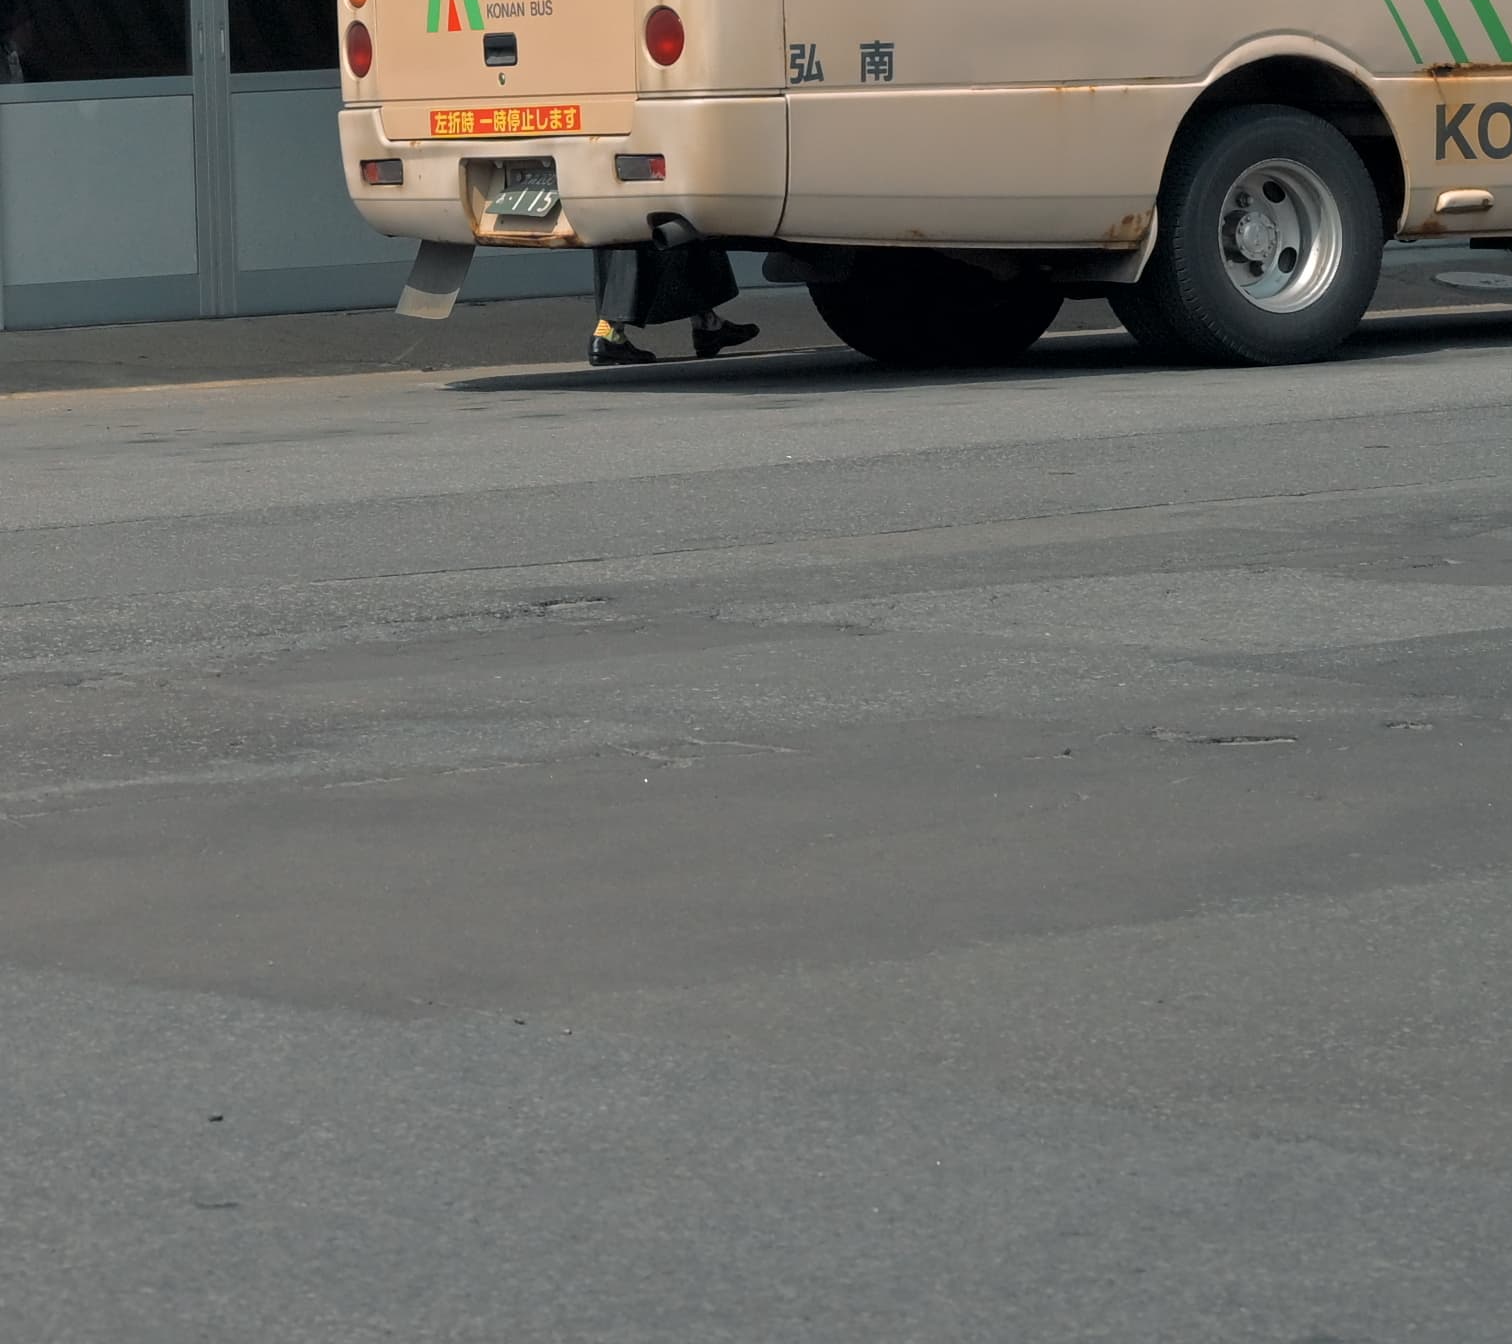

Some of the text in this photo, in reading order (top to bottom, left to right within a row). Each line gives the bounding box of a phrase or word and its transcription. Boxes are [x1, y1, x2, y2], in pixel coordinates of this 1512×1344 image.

[486, 0, 554, 19] KONAN BUS
[434, 107, 577, 134] 左折時 一時停止します
